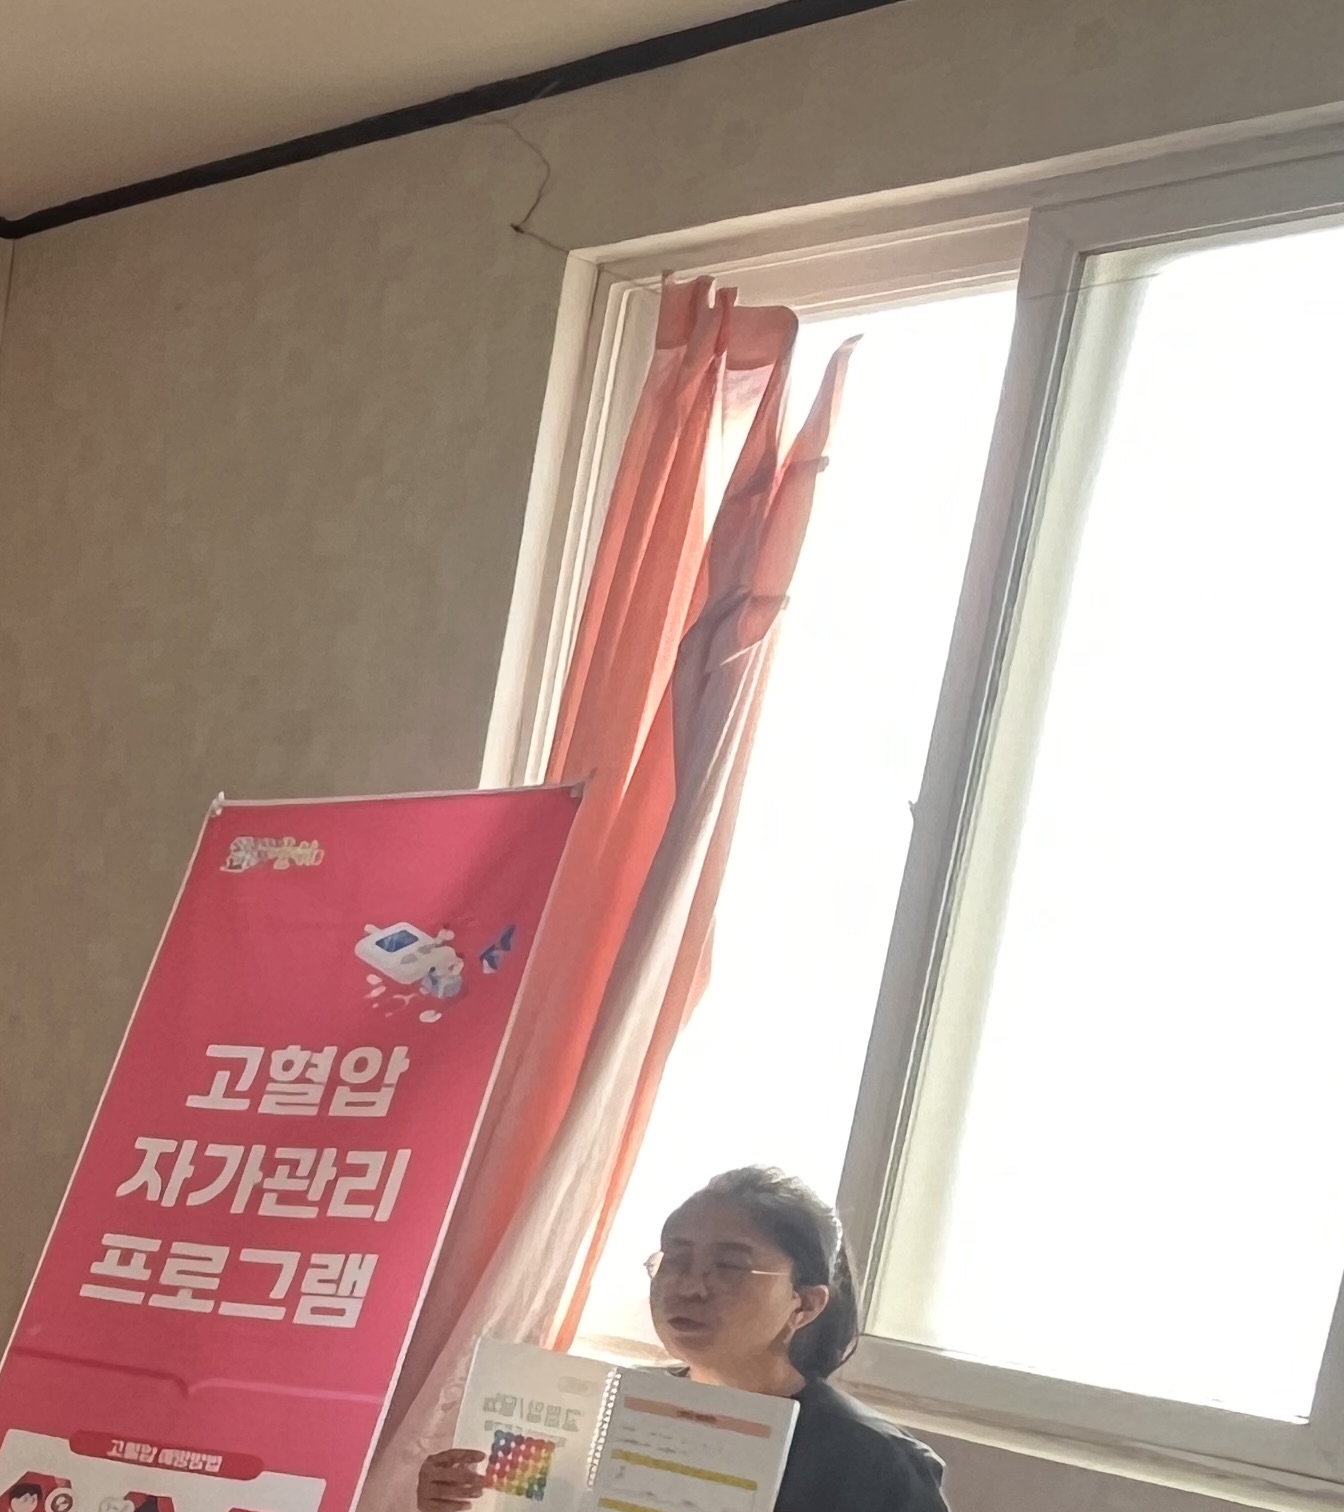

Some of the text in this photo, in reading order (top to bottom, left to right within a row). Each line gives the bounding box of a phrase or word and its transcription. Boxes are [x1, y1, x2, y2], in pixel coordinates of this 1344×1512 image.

[185, 1044, 411, 1118] 고혈압
[115, 1136, 412, 1222] 자가관리
[79, 1233, 379, 1328] 프로그램
